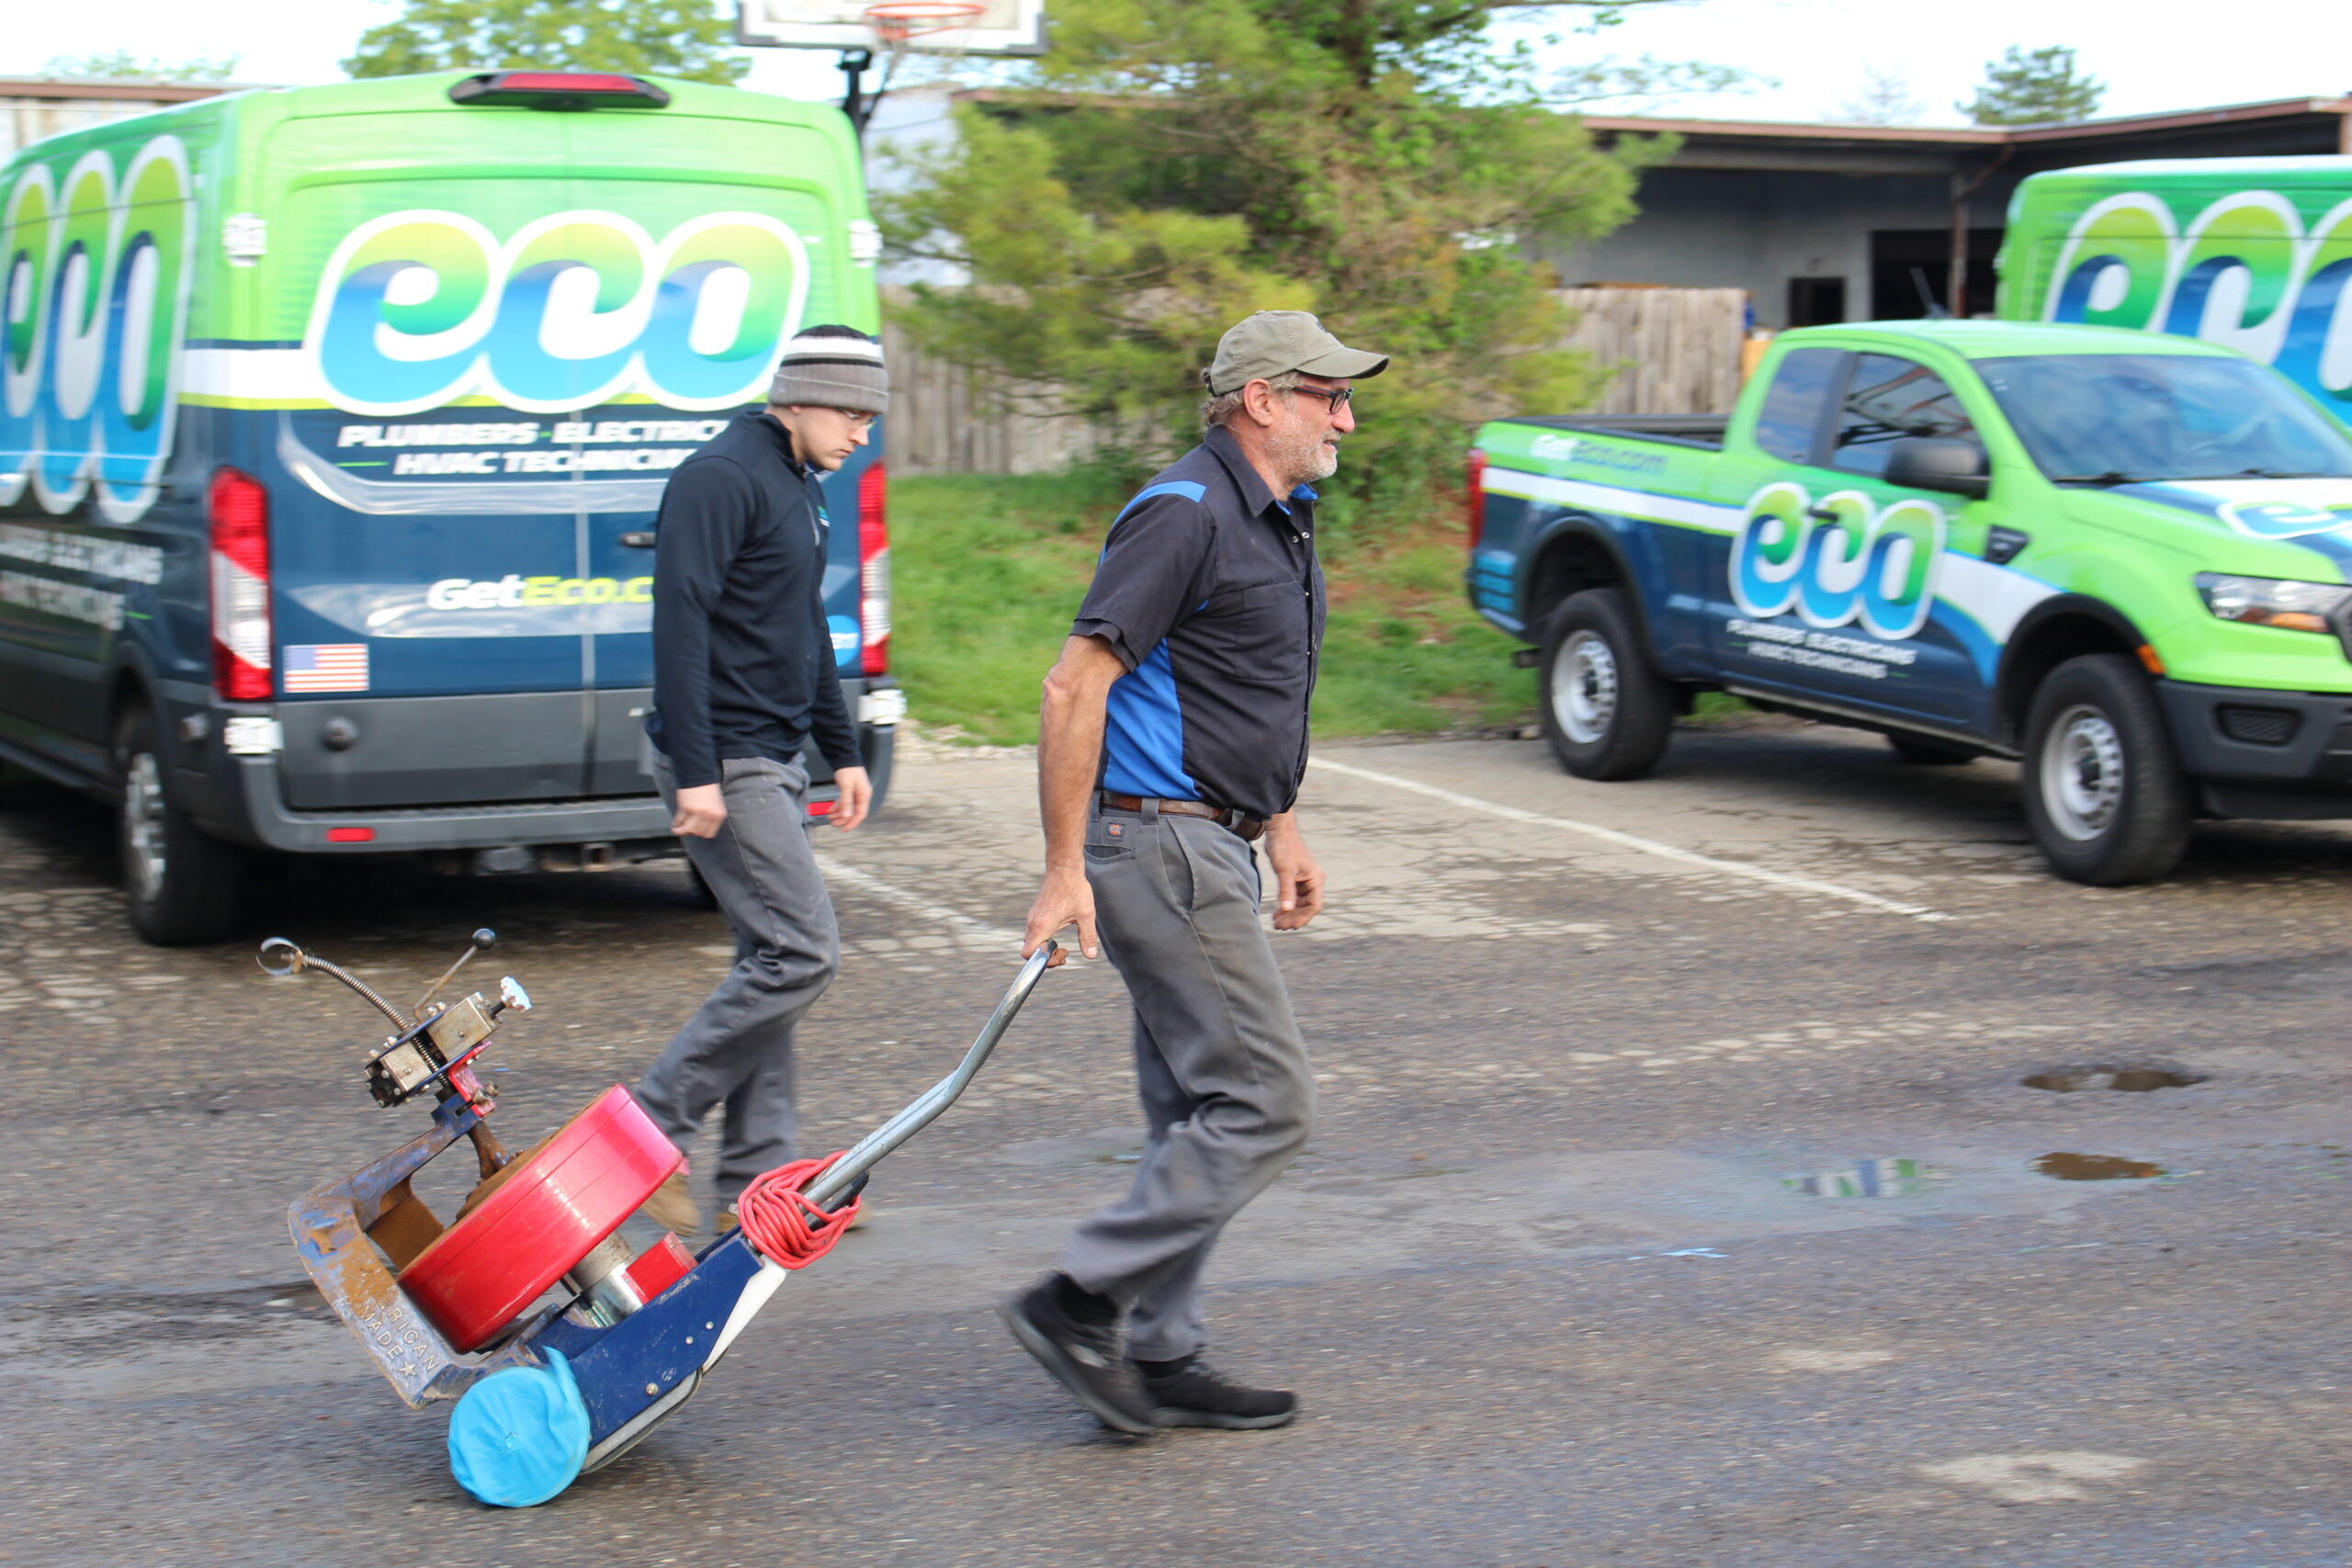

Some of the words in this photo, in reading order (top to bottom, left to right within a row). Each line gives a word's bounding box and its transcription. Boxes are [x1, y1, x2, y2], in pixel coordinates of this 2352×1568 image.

[308, 209, 808, 416] eco
[336, 423, 540, 447] PLUMBERS
[393, 451, 501, 475] HVAC
[1728, 480, 1946, 640] eco
[360, 1304, 404, 1359] MADE
